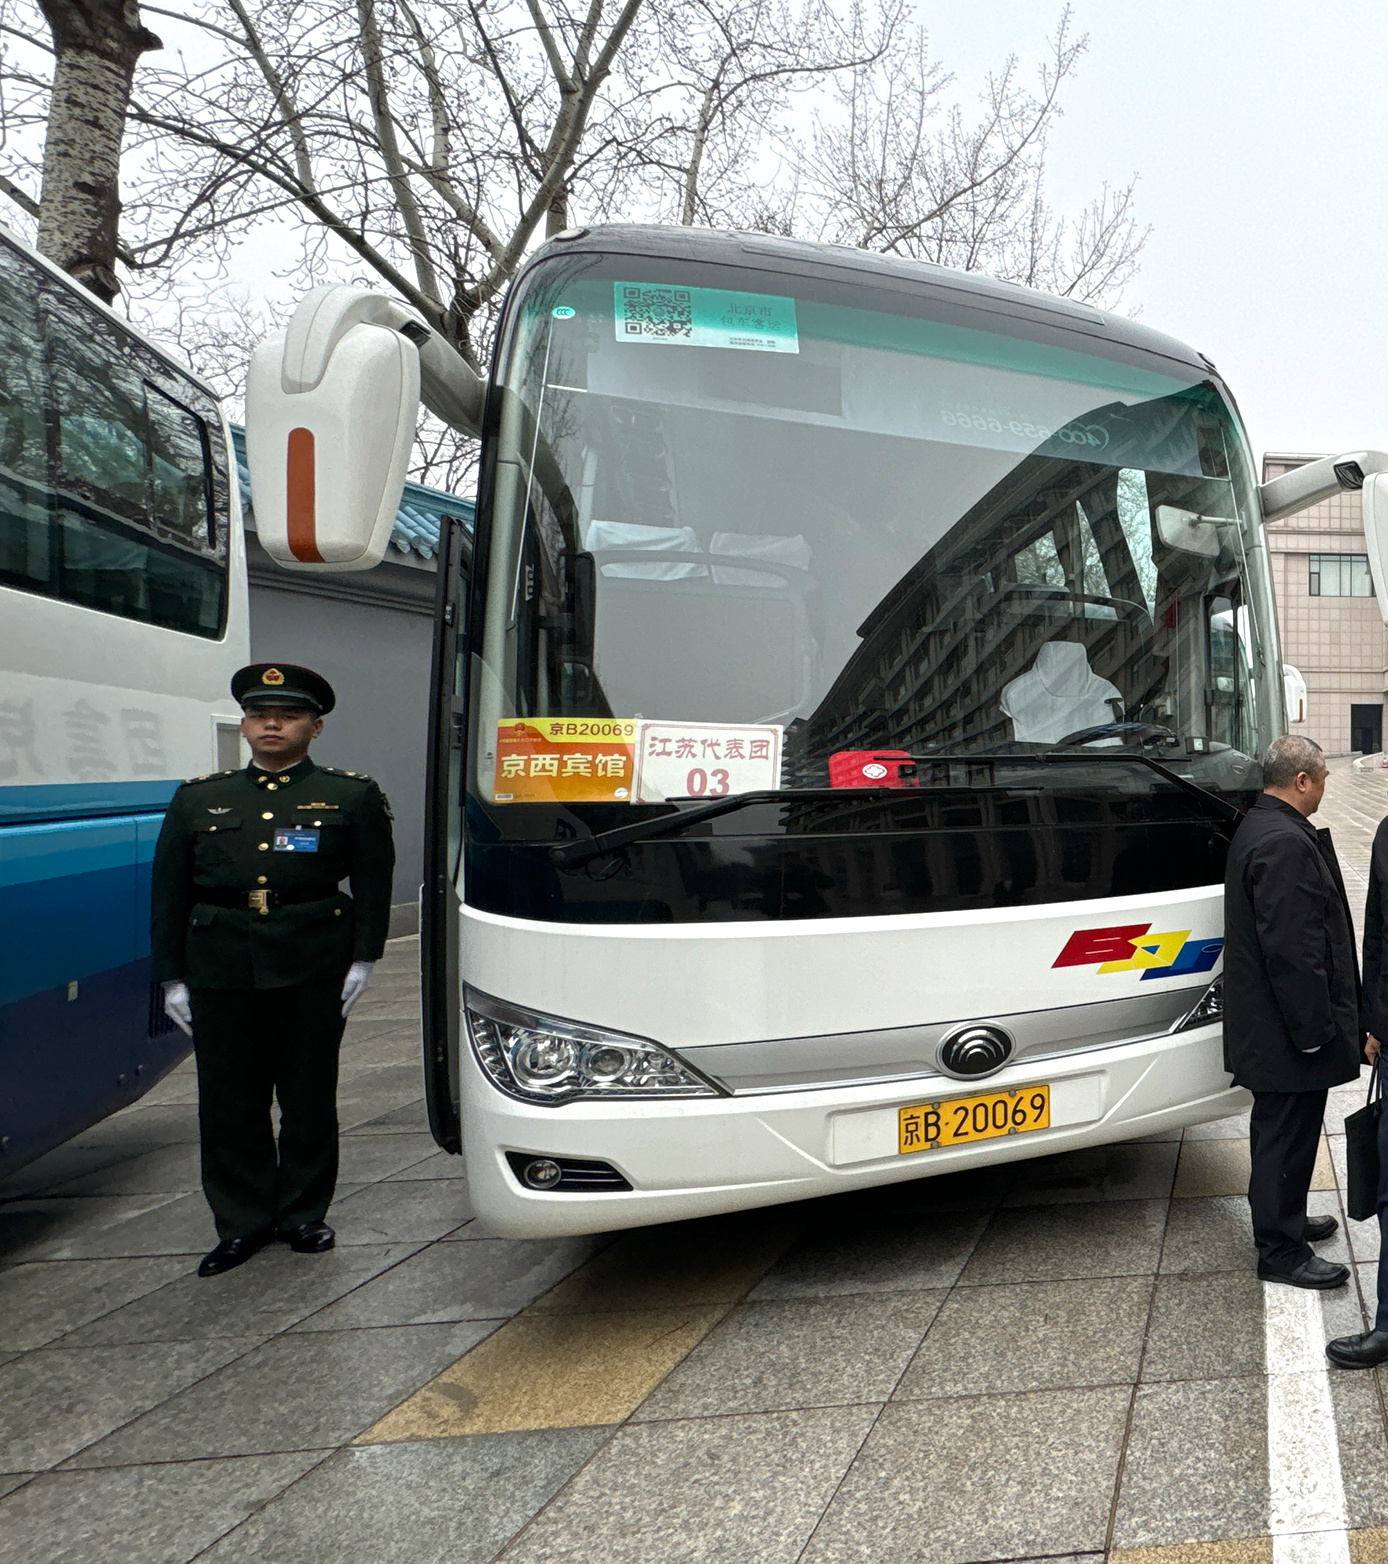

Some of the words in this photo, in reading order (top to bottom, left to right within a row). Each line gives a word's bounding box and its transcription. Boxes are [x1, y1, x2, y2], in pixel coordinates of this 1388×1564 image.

[727, 303, 772, 316] 北京市
[548, 722, 634, 737] 京B20069
[648, 736, 771, 761] 江苏代表团
[500, 753, 627, 779] 京西宾馆
[686, 768, 731, 798] 03
